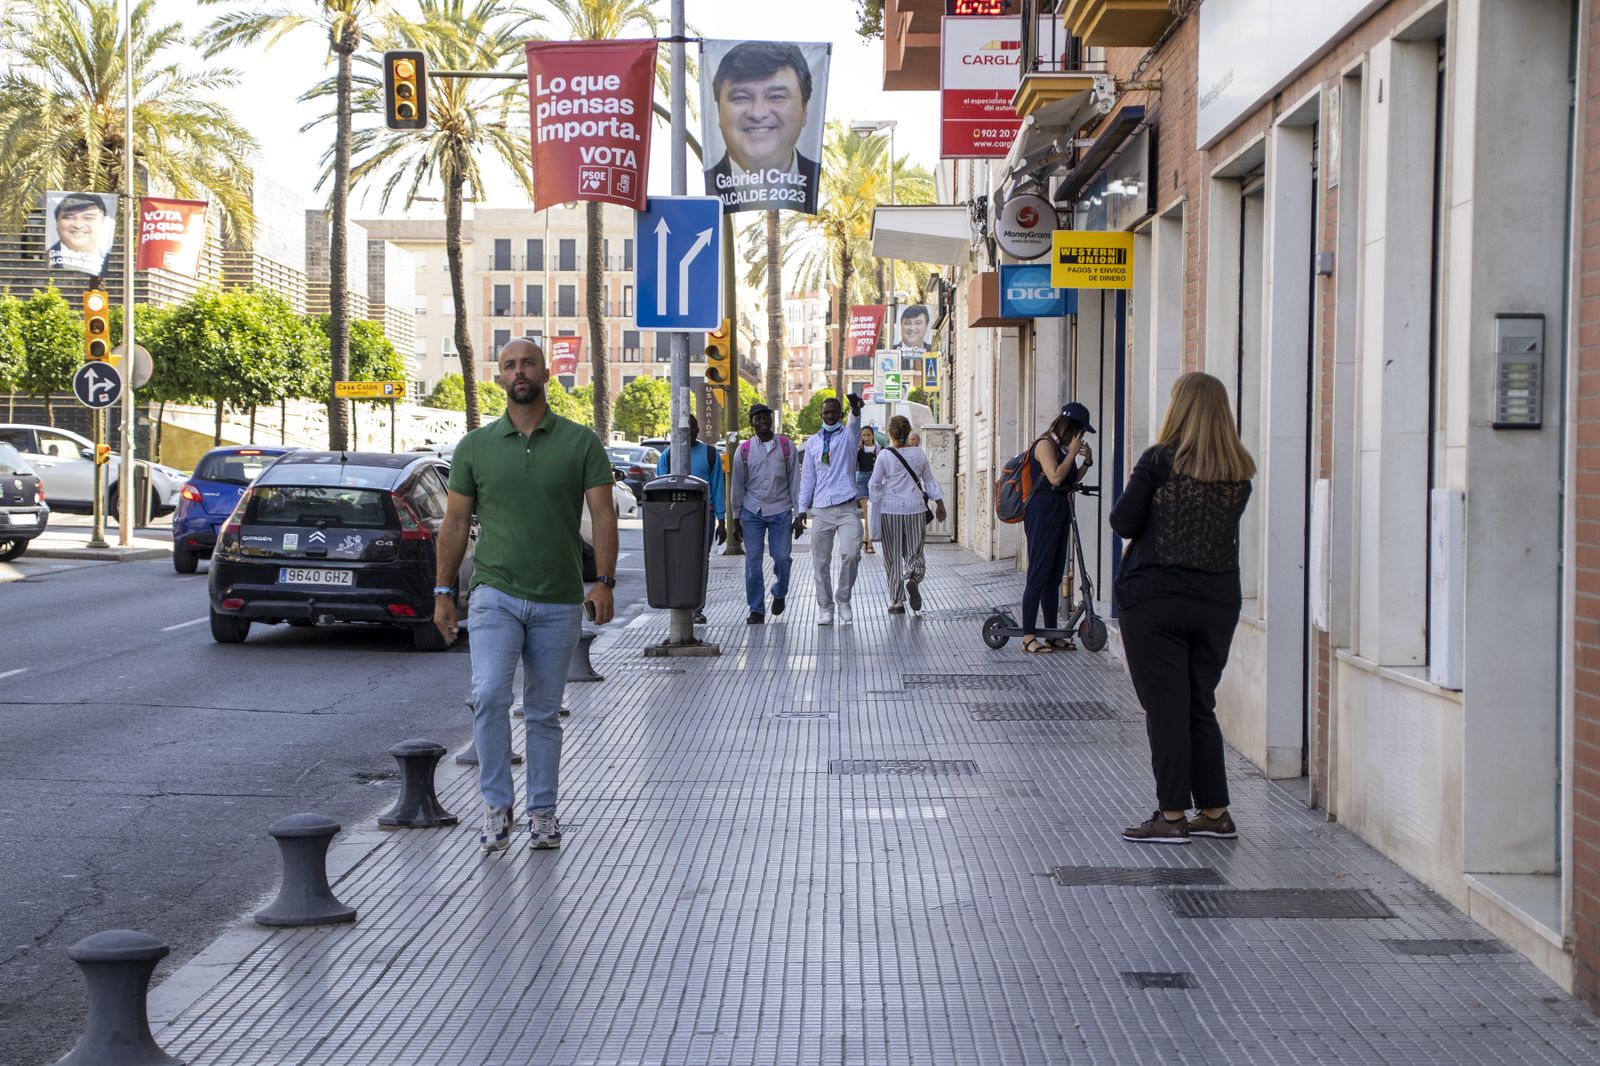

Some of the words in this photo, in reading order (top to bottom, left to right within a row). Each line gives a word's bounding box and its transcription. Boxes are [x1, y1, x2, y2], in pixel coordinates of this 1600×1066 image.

[536, 74, 567, 97] Lo
[570, 74, 620, 96] que
[536, 95, 635, 127] piensas
[536, 117, 641, 144] importa.
[981, 129, 997, 138] 902
[999, 129, 1010, 138] 20
[579, 146, 638, 170] VOTA
[582, 170, 607, 181] PSOE
[716, 169, 765, 190] Gabriel
[766, 168, 808, 187] Cruz
[720, 188, 768, 206] ALCALDE
[769, 188, 806, 204] 2023
[143, 209, 183, 222] VOTA
[156, 221, 185, 234] que
[1003, 230, 1051, 240] MoneyGram
[1060, 247, 1116, 256] WESTERN
[1077, 256, 1116, 264] UNION
[1100, 267, 1127, 275] ENVÍOS
[1007, 287, 1061, 300] DIGI
[375, 539, 395, 547] C4
[288, 570, 321, 582] 9640
[324, 571, 349, 584] GHZ
